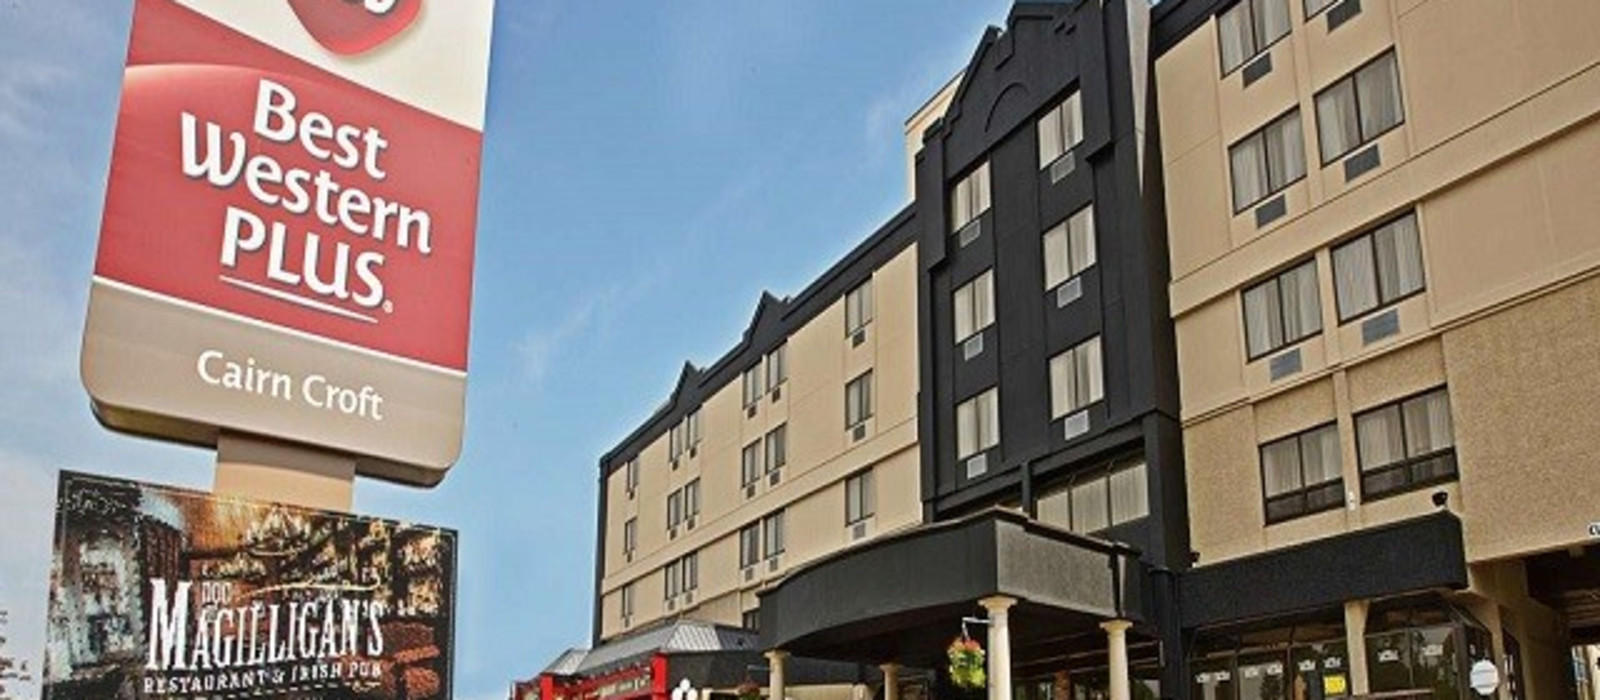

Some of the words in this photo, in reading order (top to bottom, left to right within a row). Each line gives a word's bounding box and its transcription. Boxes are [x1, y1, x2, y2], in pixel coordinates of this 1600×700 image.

[254, 77, 388, 179] Best
[181, 112, 431, 253] Western
[220, 206, 385, 307] PLUS
[197, 350, 292, 401] Cairn
[302, 375, 384, 421] Croft
[144, 669, 266, 693] RESTAURANT
[291, 662, 342, 682] IRISH
[348, 661, 381, 678] PUB
